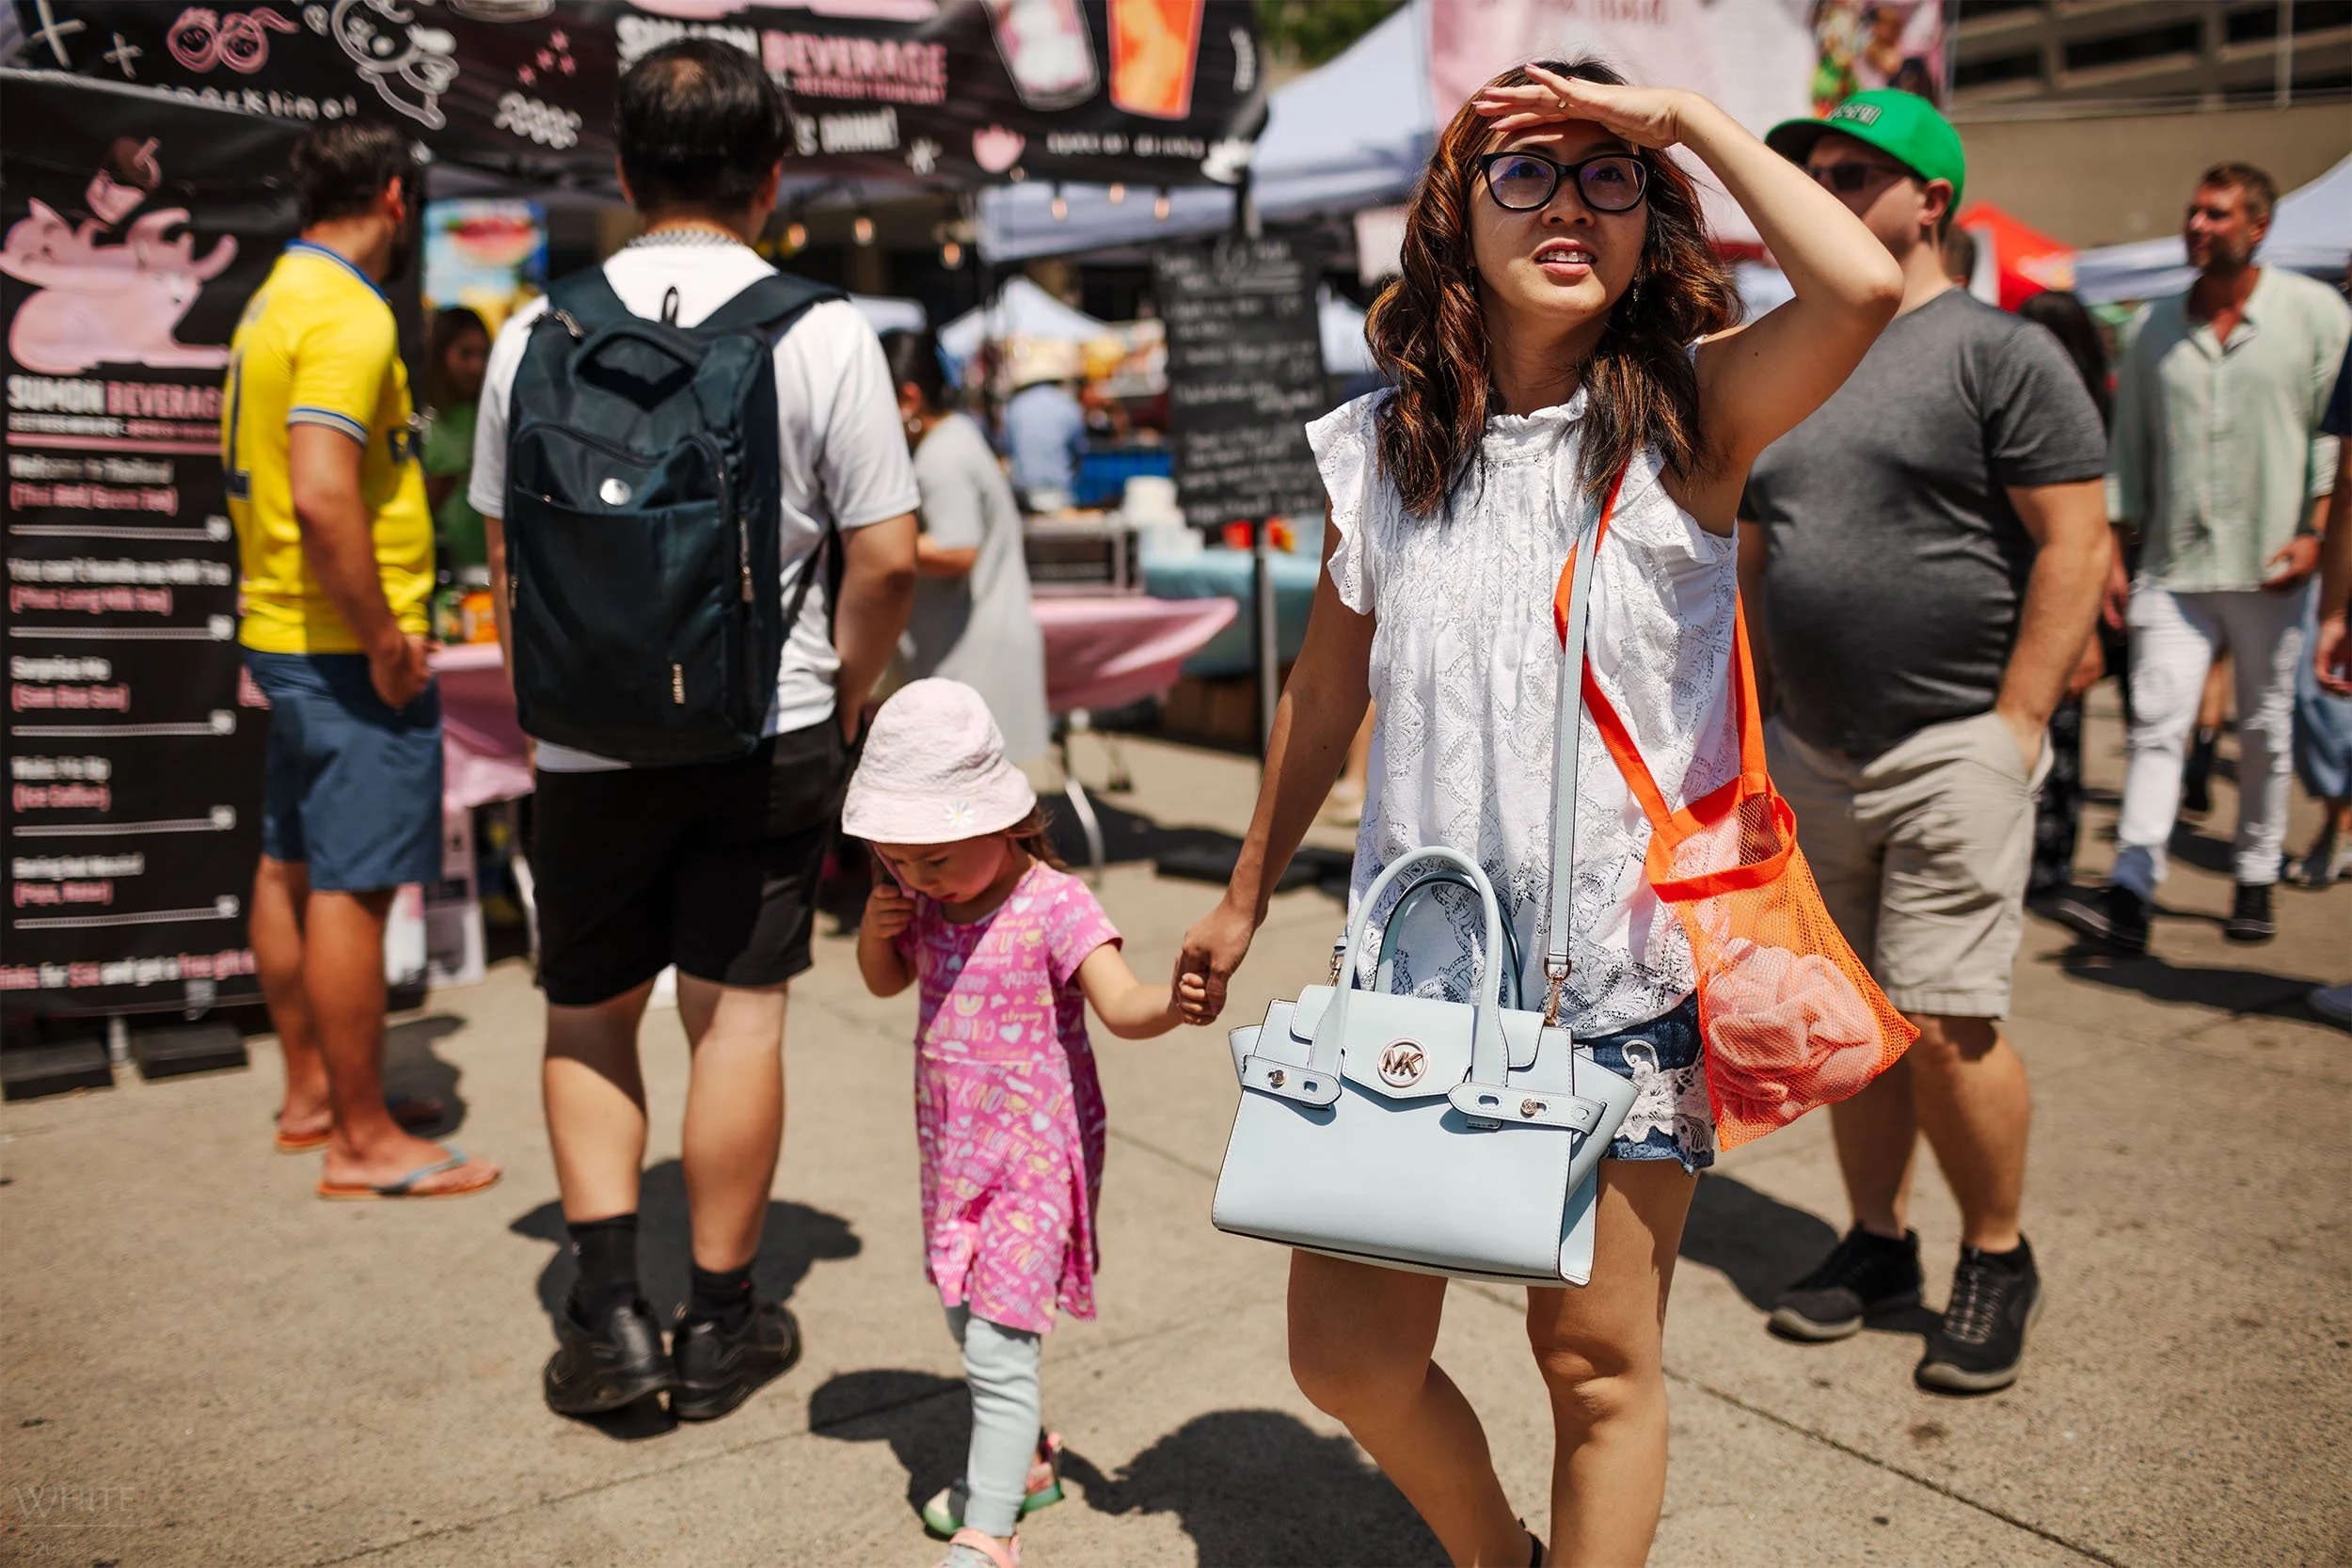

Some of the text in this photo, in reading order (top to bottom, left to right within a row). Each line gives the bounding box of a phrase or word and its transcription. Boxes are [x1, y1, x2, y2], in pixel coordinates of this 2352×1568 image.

[760, 29, 947, 87] BEVERAGE
[8, 374, 224, 420] SUMON BEVERAG
[1380, 1046, 1425, 1078] MK
[956, 1078, 1006, 1115] KIND
